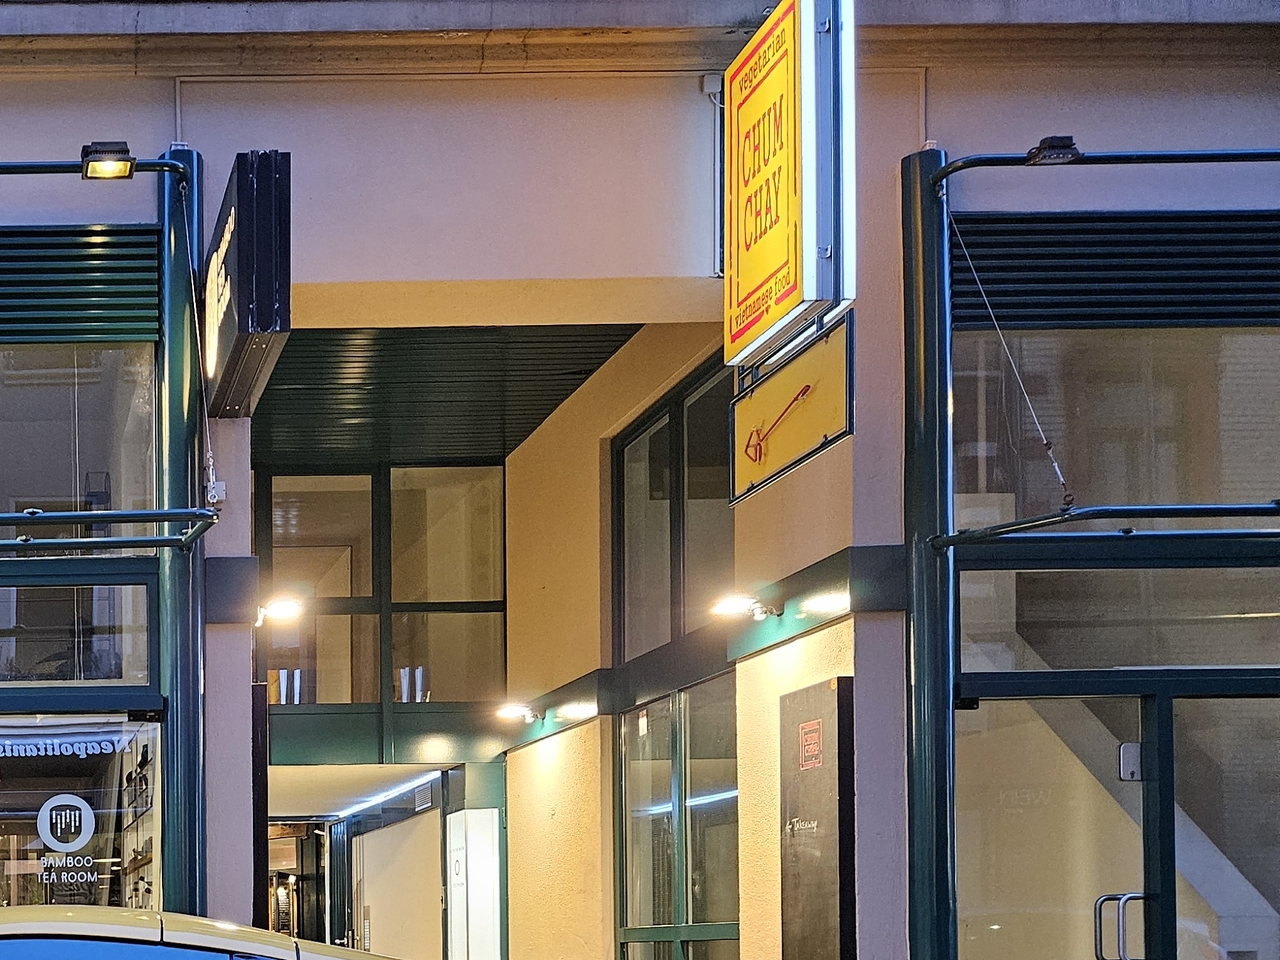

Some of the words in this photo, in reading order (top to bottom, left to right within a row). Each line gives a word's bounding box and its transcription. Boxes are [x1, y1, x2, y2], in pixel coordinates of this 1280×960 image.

[738, 27, 786, 96] vegetarian
[742, 93, 784, 188] CHUM
[744, 165, 782, 252] CHAY
[734, 286, 773, 329] vietnamese
[774, 266, 791, 296] food
[36, 871, 57, 883] TEA
[61, 871, 98, 882] ROOM
[40, 856, 93, 867] BAMBOO
